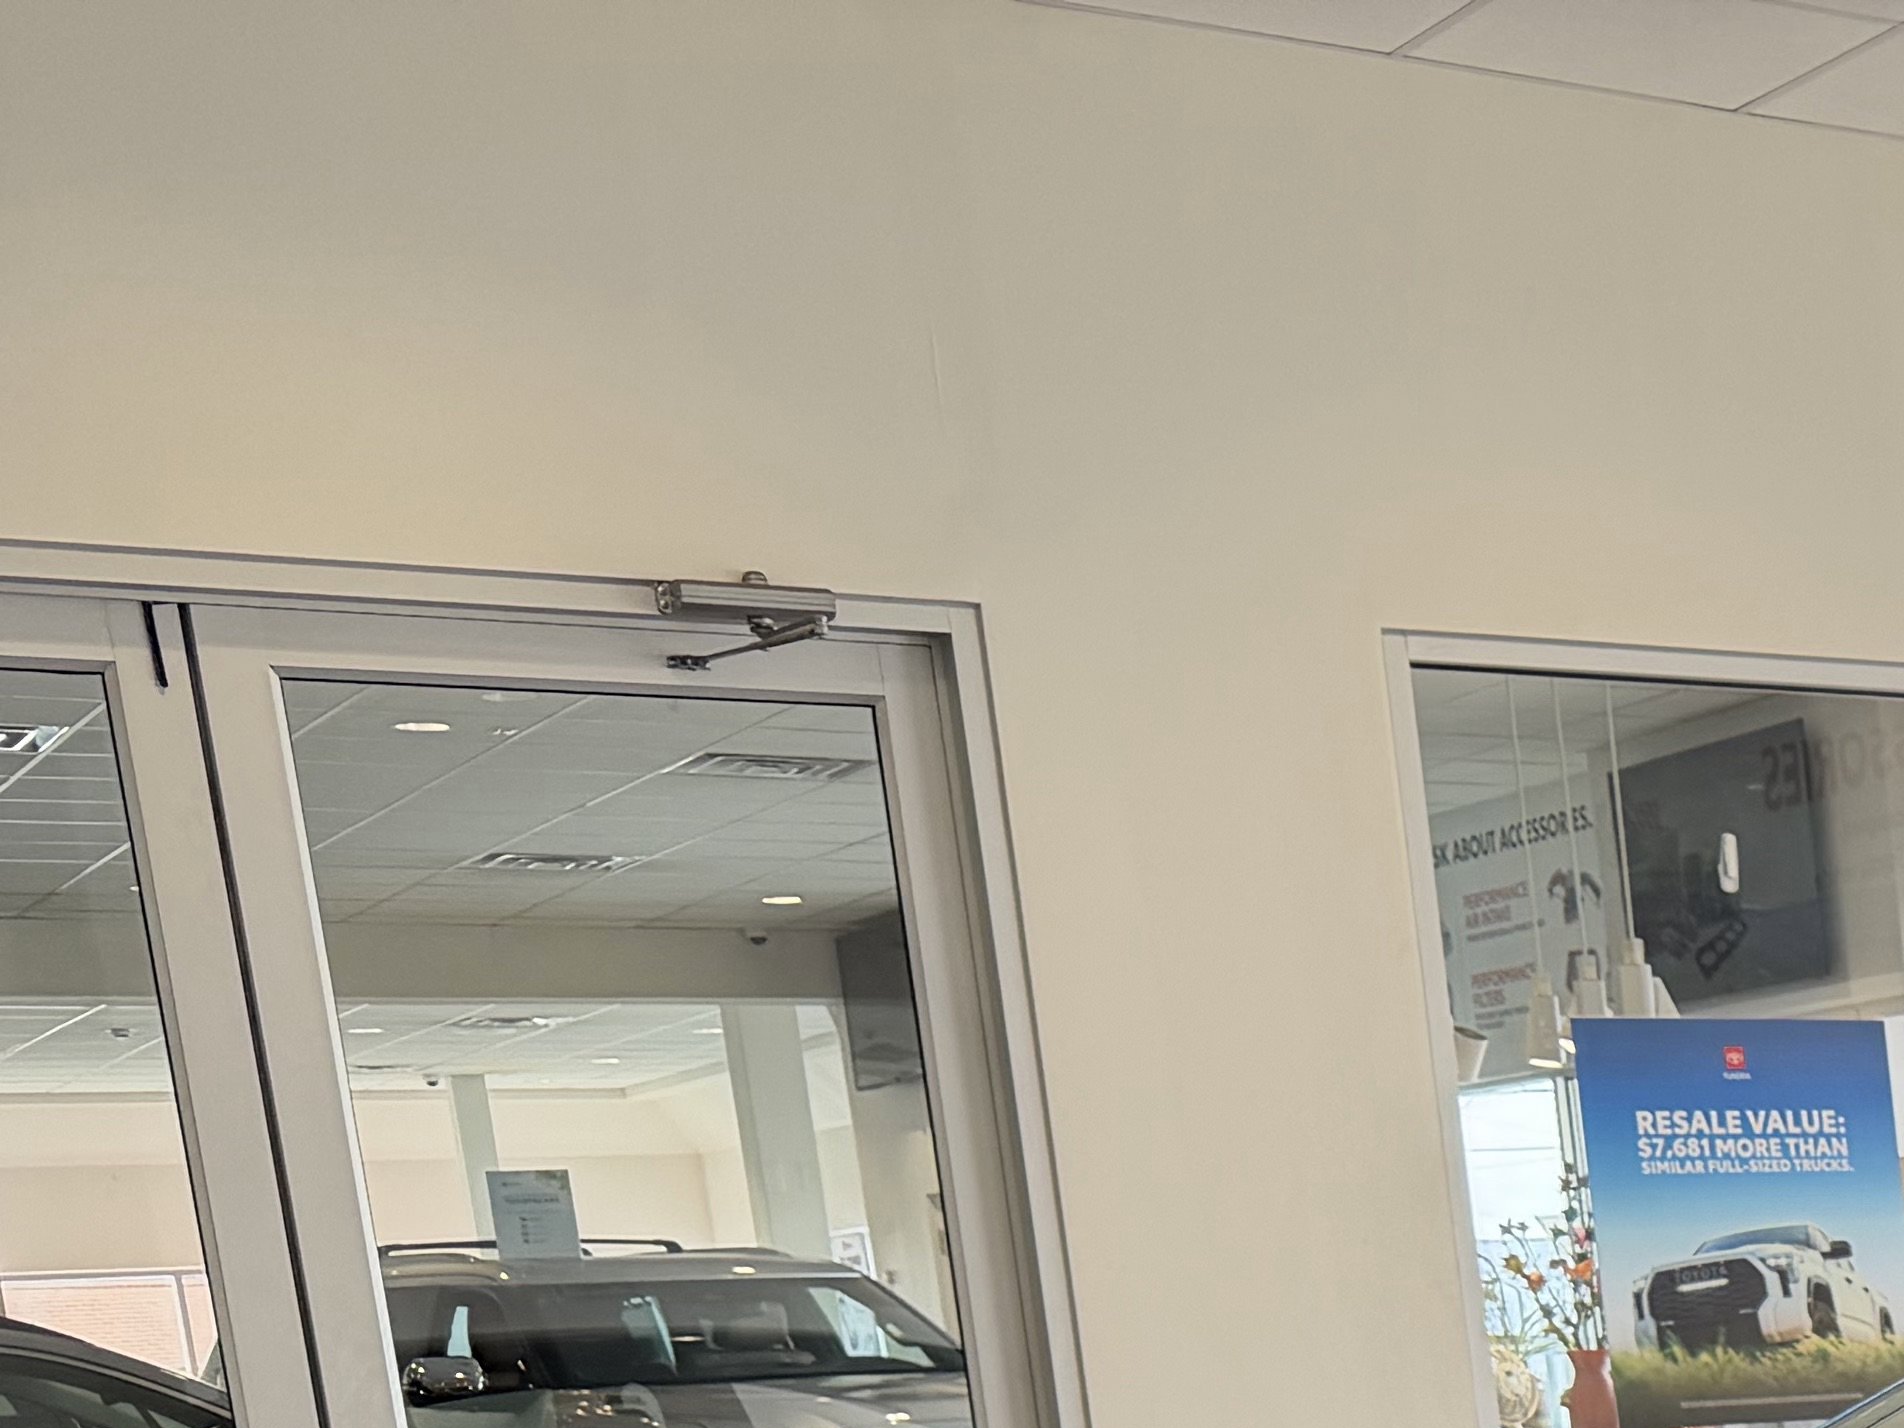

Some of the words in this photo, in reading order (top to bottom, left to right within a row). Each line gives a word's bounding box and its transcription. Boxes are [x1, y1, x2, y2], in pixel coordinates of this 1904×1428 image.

[1452, 830, 1496, 864] ABOUT
[1500, 805, 1593, 850] ACCESSORES.
[1635, 1110, 1742, 1135] RESALE
[1745, 1109, 1846, 1134] VALUE:
[1637, 1137, 1710, 1159] $7,681
[1715, 1137, 1782, 1158] MORE
[1785, 1137, 1848, 1157] THAN
[1641, 1160, 1705, 1174] SIMILAR
[1708, 1159, 1790, 1174] FULL-SIZED
[1793, 1158, 1854, 1172] TRUCKS.
